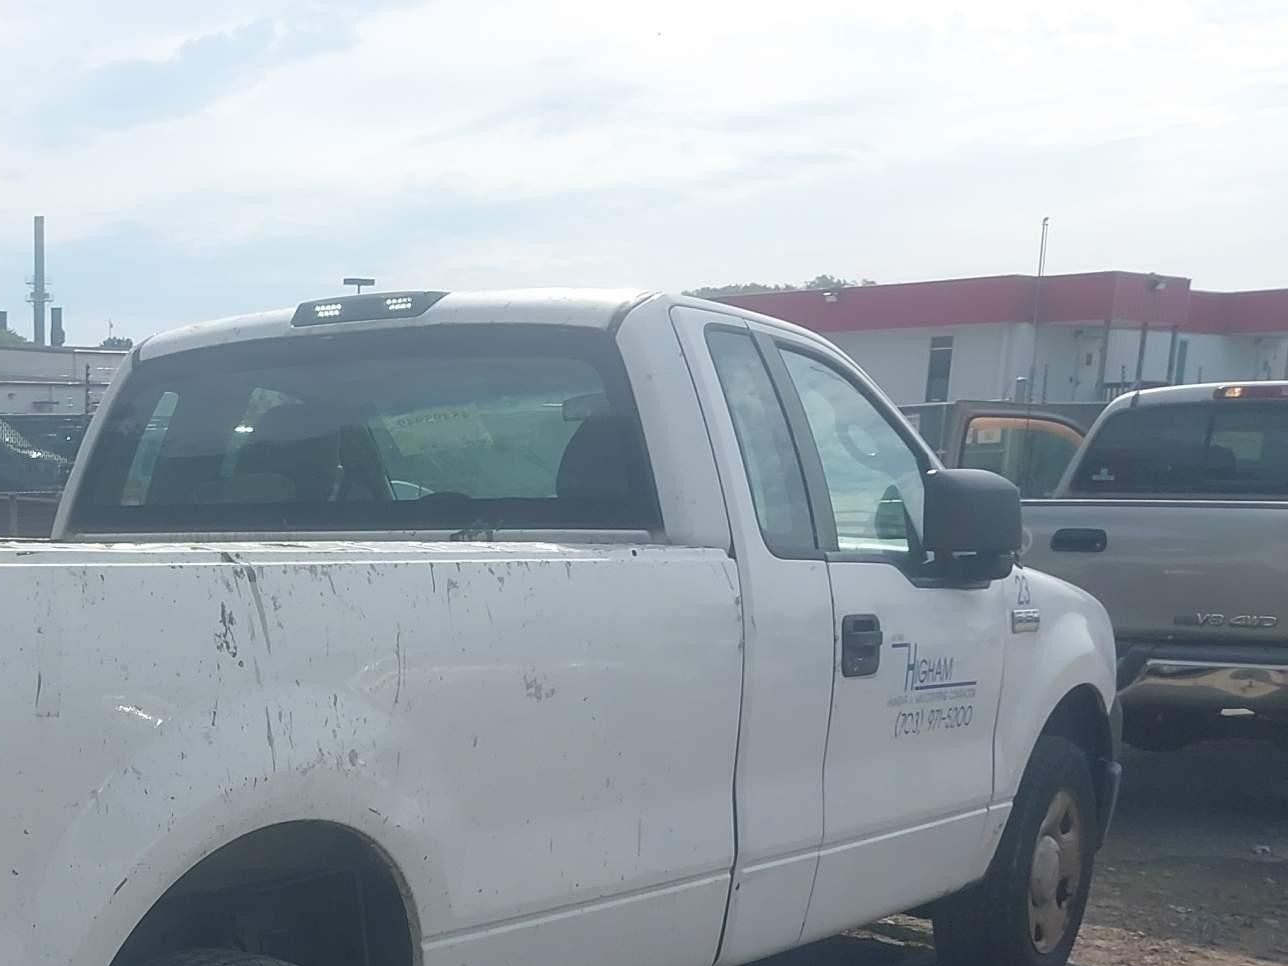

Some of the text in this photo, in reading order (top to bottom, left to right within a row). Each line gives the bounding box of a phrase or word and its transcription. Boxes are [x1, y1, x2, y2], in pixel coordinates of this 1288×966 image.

[1015, 575, 1031, 605] 23
[1194, 612, 1278, 627] V8 4WD
[904, 642, 954, 692] HIGHAM
[894, 705, 974, 739] (703) 971-5200
